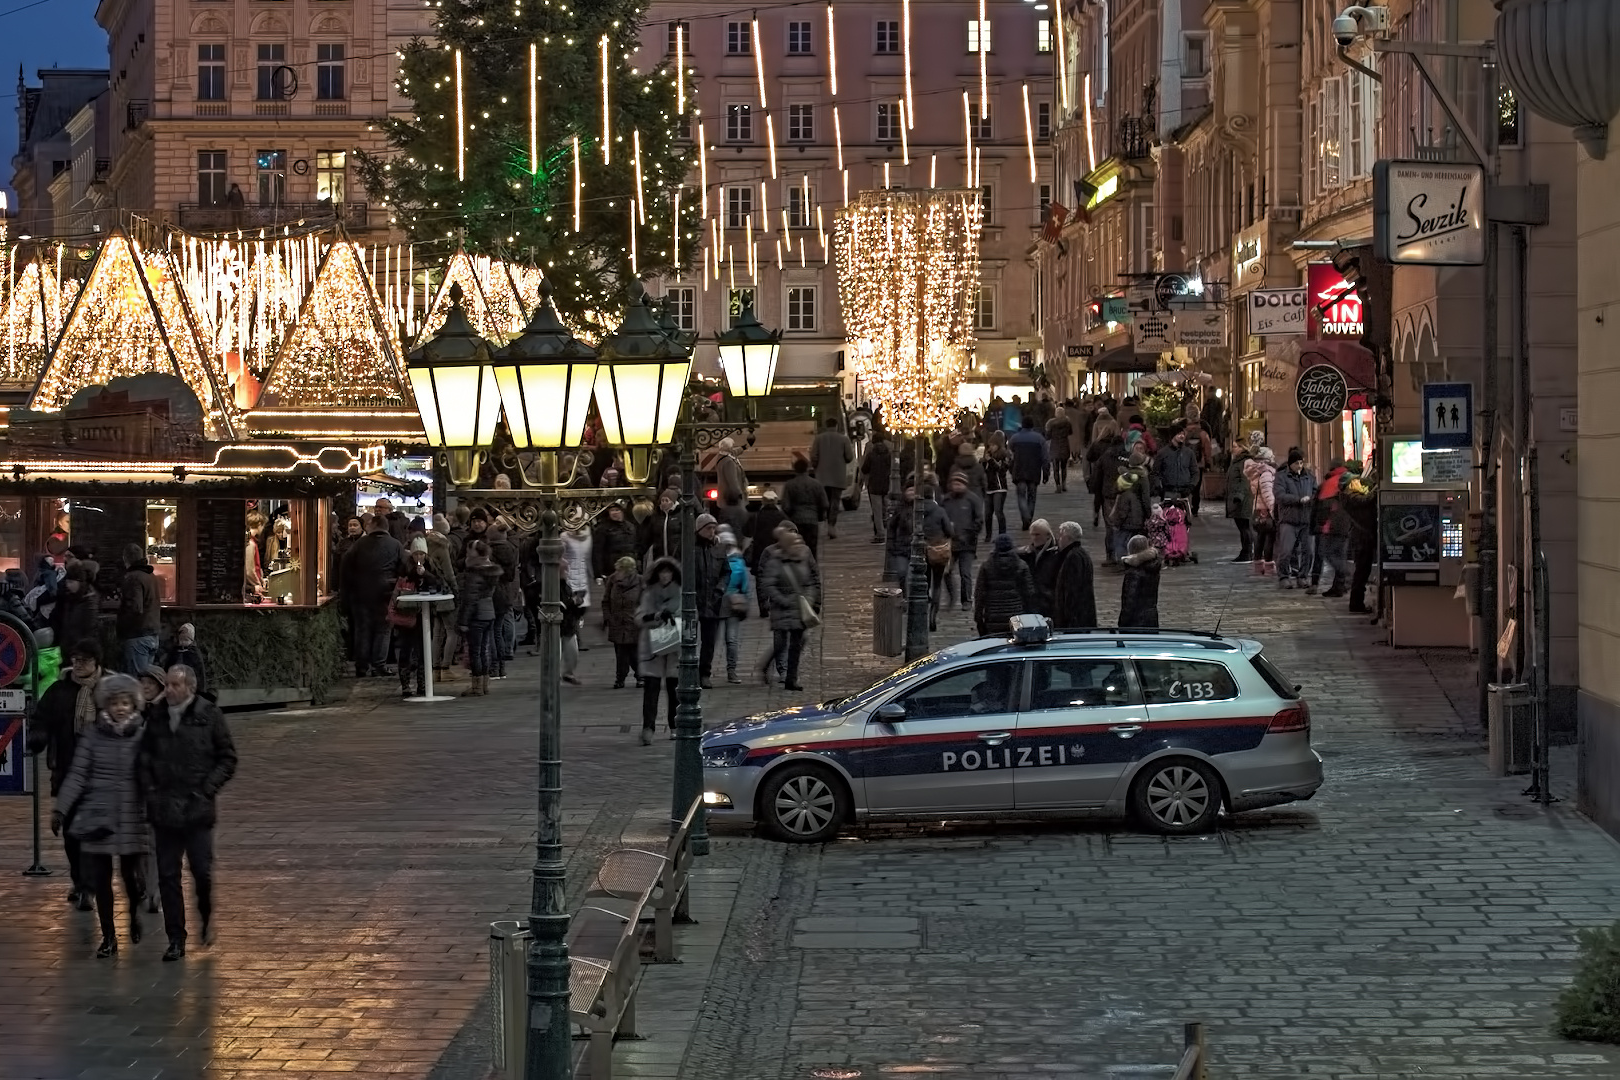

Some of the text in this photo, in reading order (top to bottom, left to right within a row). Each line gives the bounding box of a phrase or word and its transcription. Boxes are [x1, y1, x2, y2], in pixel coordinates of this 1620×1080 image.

[1397, 170, 1472, 180] DAMEN- UND HERRENSALON
[1397, 186, 1468, 240] Sevzik
[1258, 319, 1273, 330] Eis
[1180, 330, 1222, 338] restplatz
[1301, 378, 1344, 396] Tabak
[1300, 396, 1341, 413] Trafik
[1183, 682, 1214, 699] 133
[942, 745, 1066, 771] POLIZEI
